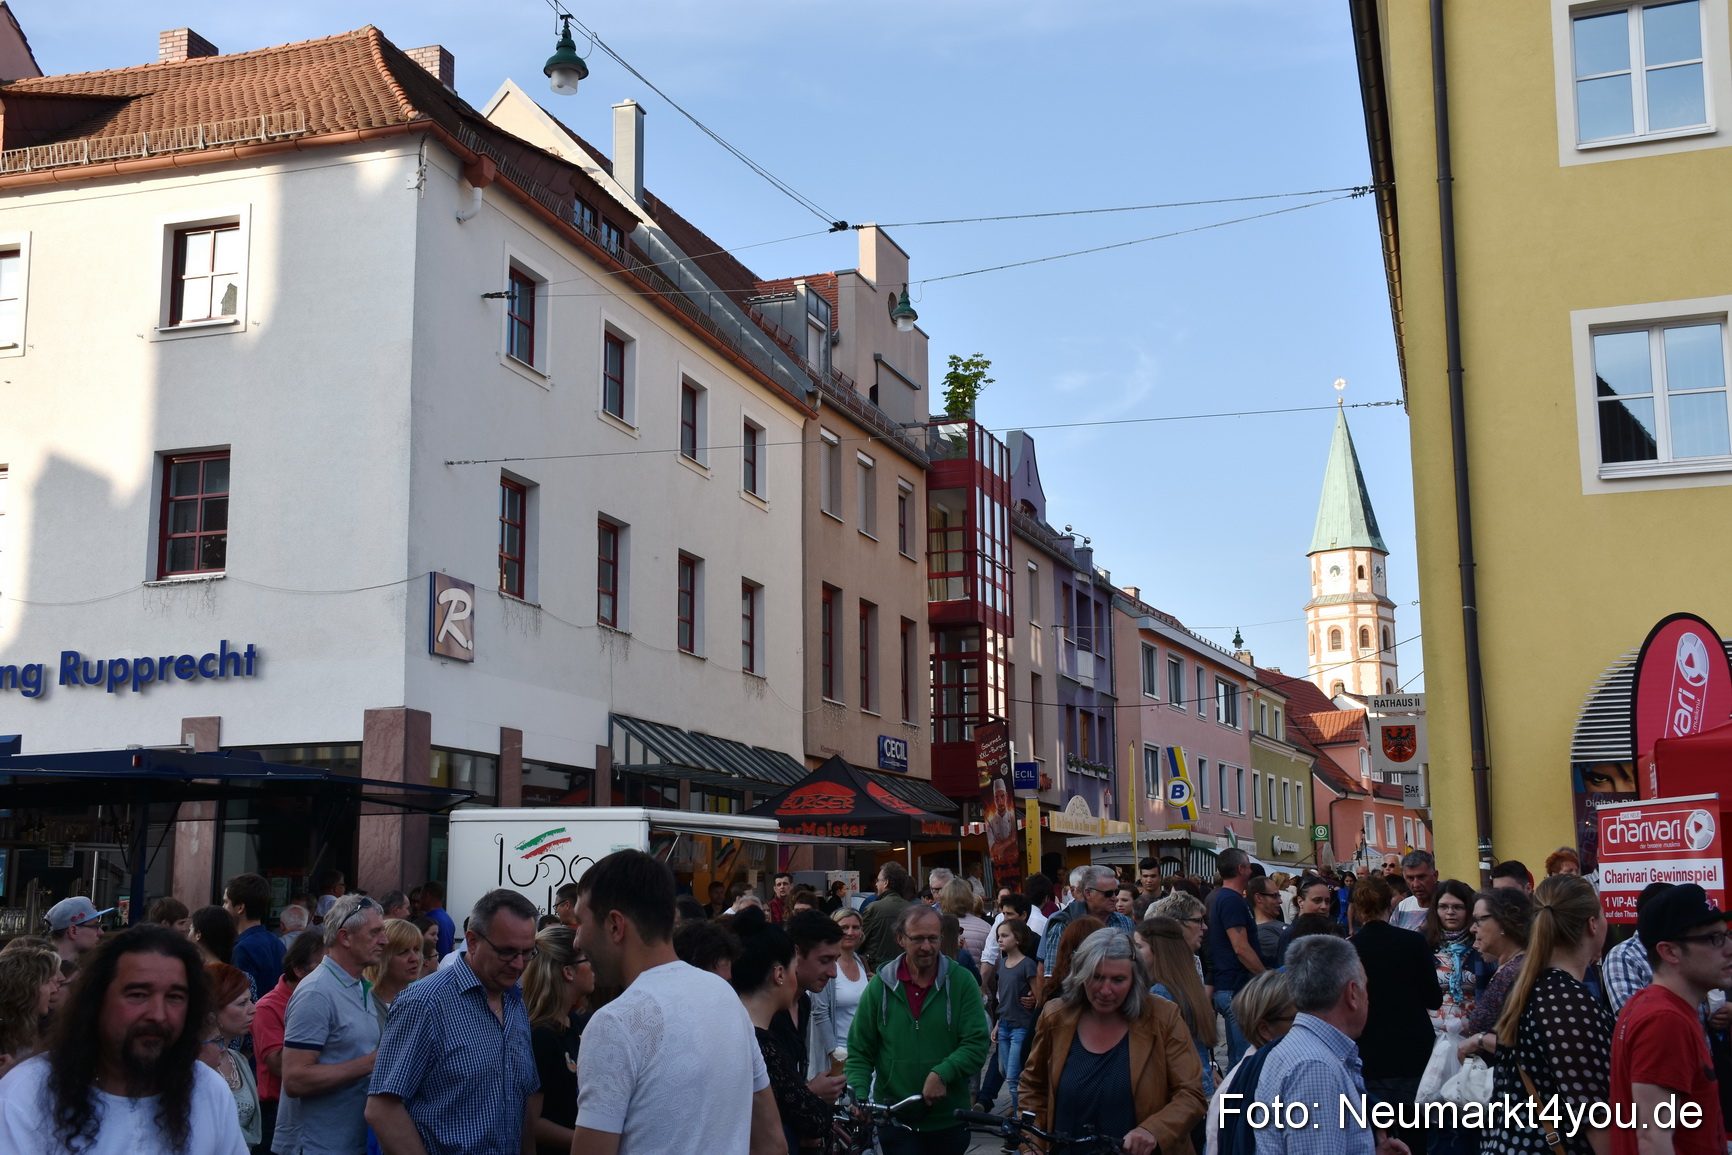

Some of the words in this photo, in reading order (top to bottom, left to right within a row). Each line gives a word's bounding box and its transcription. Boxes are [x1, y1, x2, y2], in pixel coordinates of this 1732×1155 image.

[59, 640, 257, 693] Rupprecht
[1374, 698, 1413, 708] RATHAUS
[1415, 698, 1420, 707] II
[884, 739, 907, 760] CECIL
[981, 735, 1002, 750] Gourmet
[979, 742, 1007, 759] XXL-Burger
[1015, 770, 1035, 778] ECIL
[1171, 785, 1185, 799] B
[780, 795, 855, 810] BURGER
[1607, 816, 1681, 844] charivari
[1604, 868, 1648, 884] Charivari
[1650, 866, 1717, 884] Gewinnspiel
[1605, 897, 1609, 907] 1
